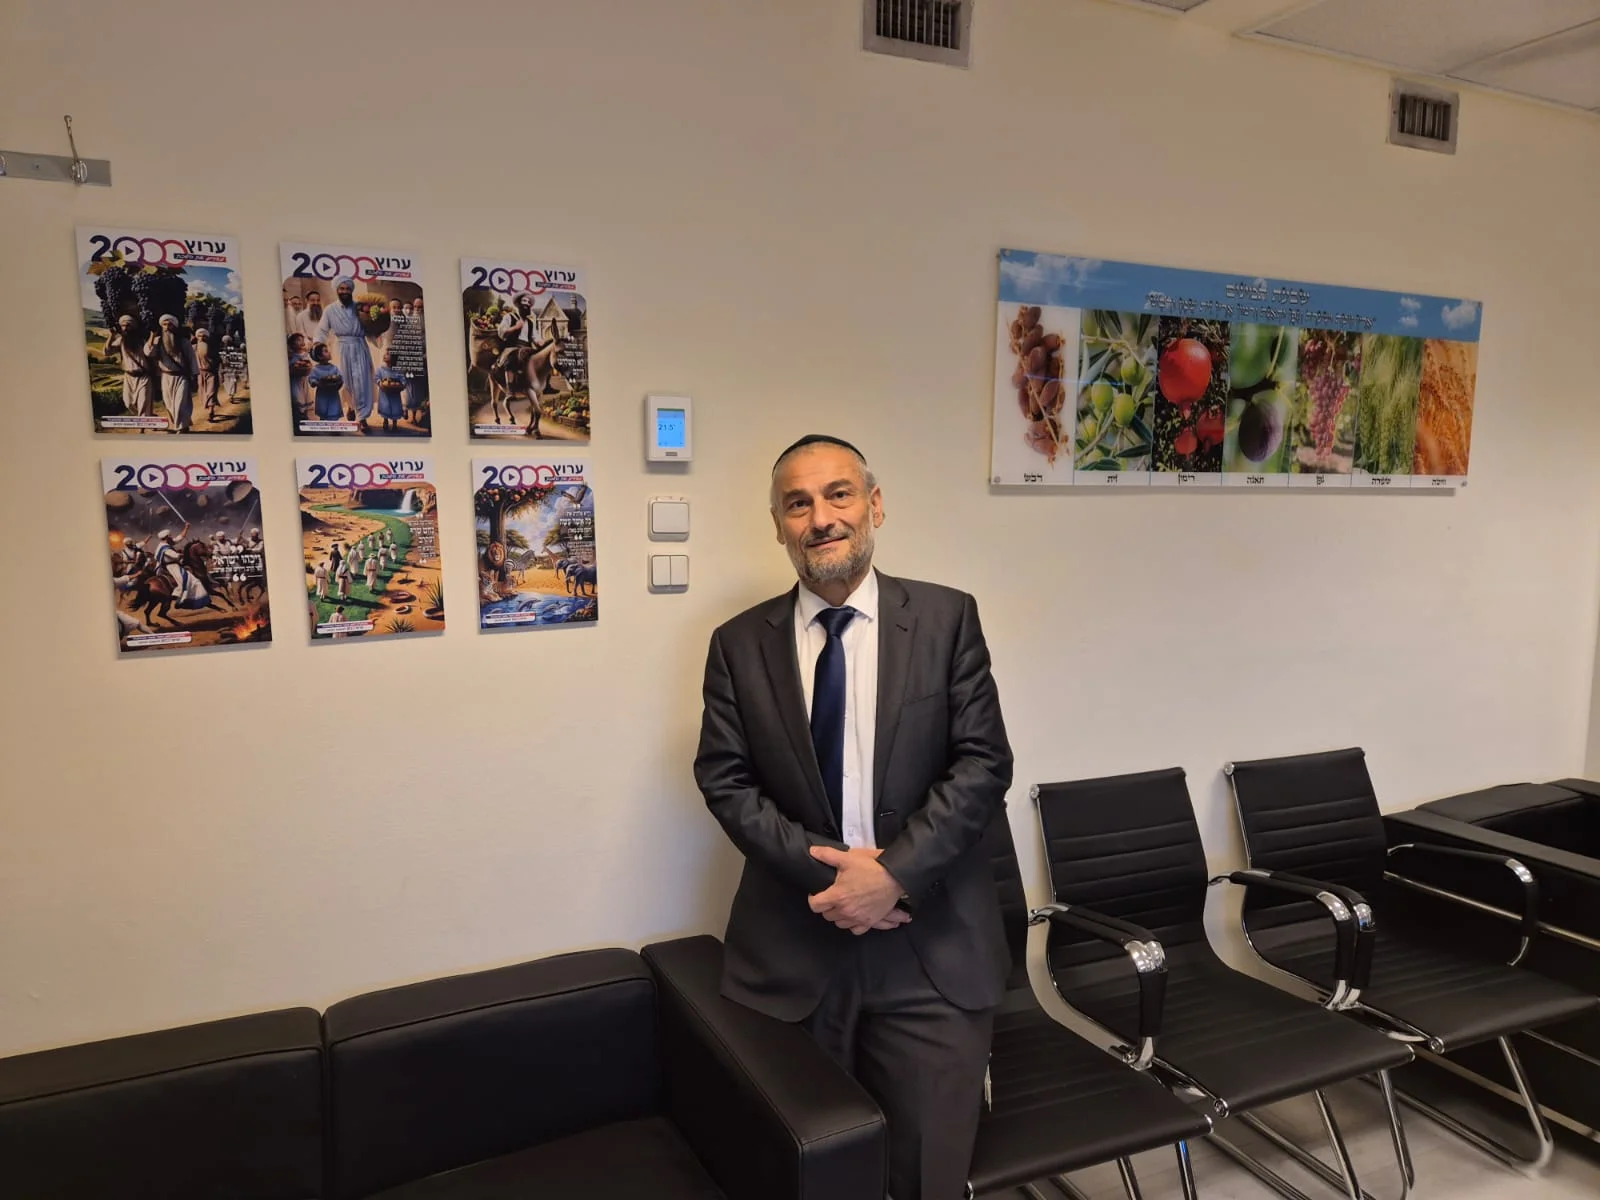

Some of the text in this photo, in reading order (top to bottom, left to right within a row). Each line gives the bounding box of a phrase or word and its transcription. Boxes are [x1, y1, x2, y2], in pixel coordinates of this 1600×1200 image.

[90, 235, 227, 268] ערוץ 2000
[291, 252, 411, 282] ערוץ 2000
[471, 266, 577, 295] ערוץ 2000
[1272, 287, 1310, 305] שבעת
[114, 461, 247, 491] ערוץ 2000
[308, 461, 424, 490] ערוץ 2000
[482, 464, 584, 490] ערוץ 2000
